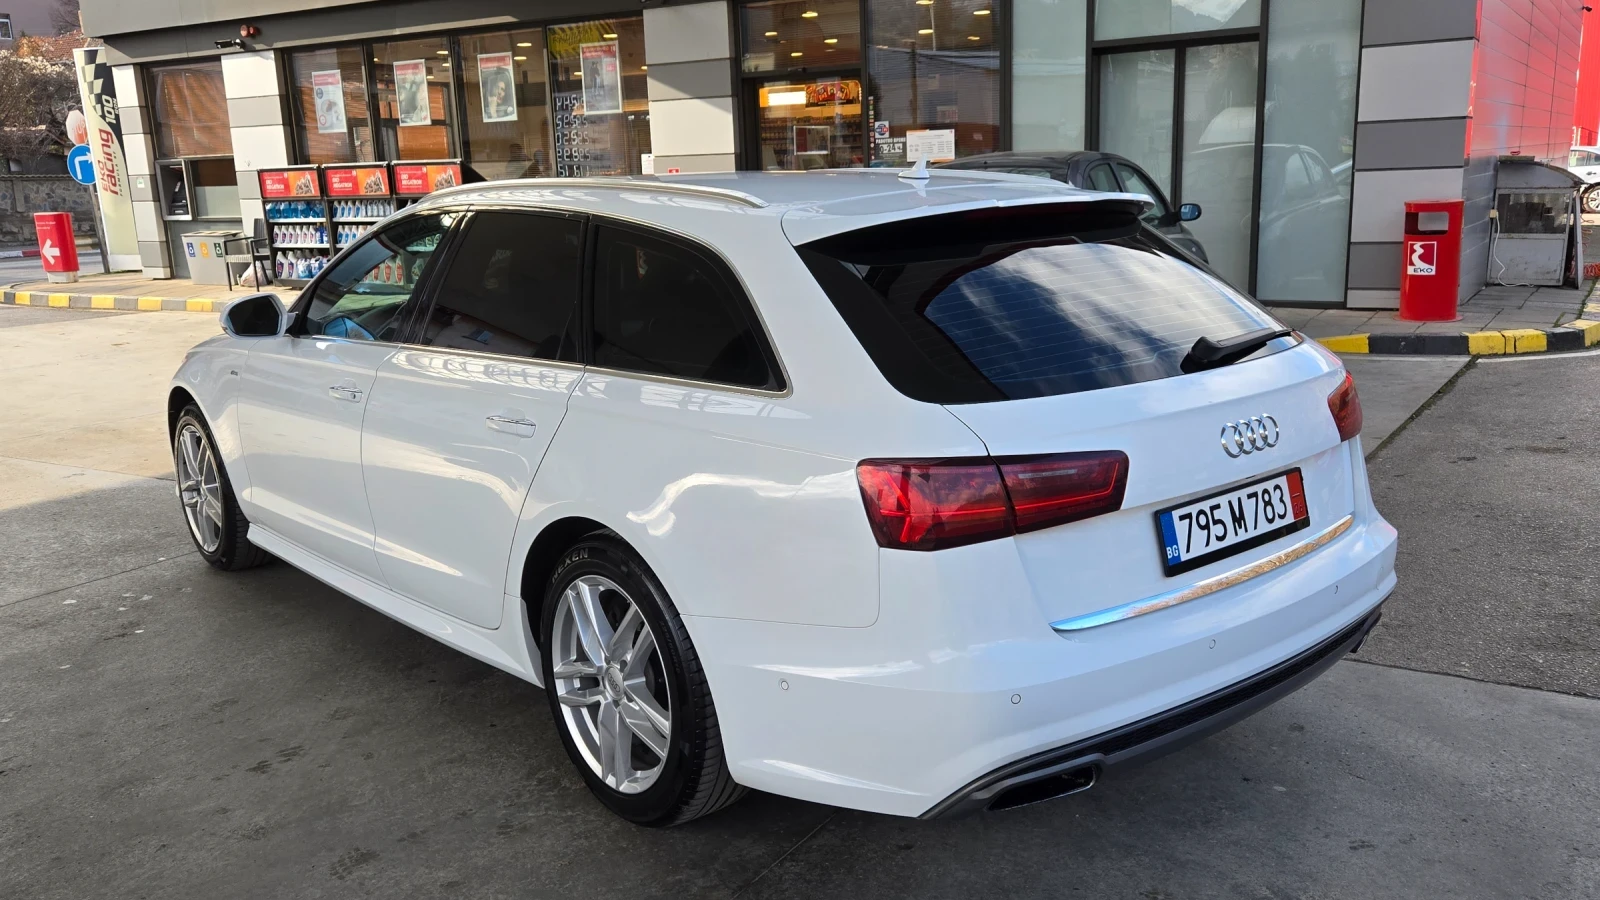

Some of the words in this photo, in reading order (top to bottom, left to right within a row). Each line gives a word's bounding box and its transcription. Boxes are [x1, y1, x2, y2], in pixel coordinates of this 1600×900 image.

[102, 95, 116, 124] 100
[99, 128, 119, 196] racing
[552, 548, 589, 584] NEXEN
[1166, 545, 1179, 559] BG
